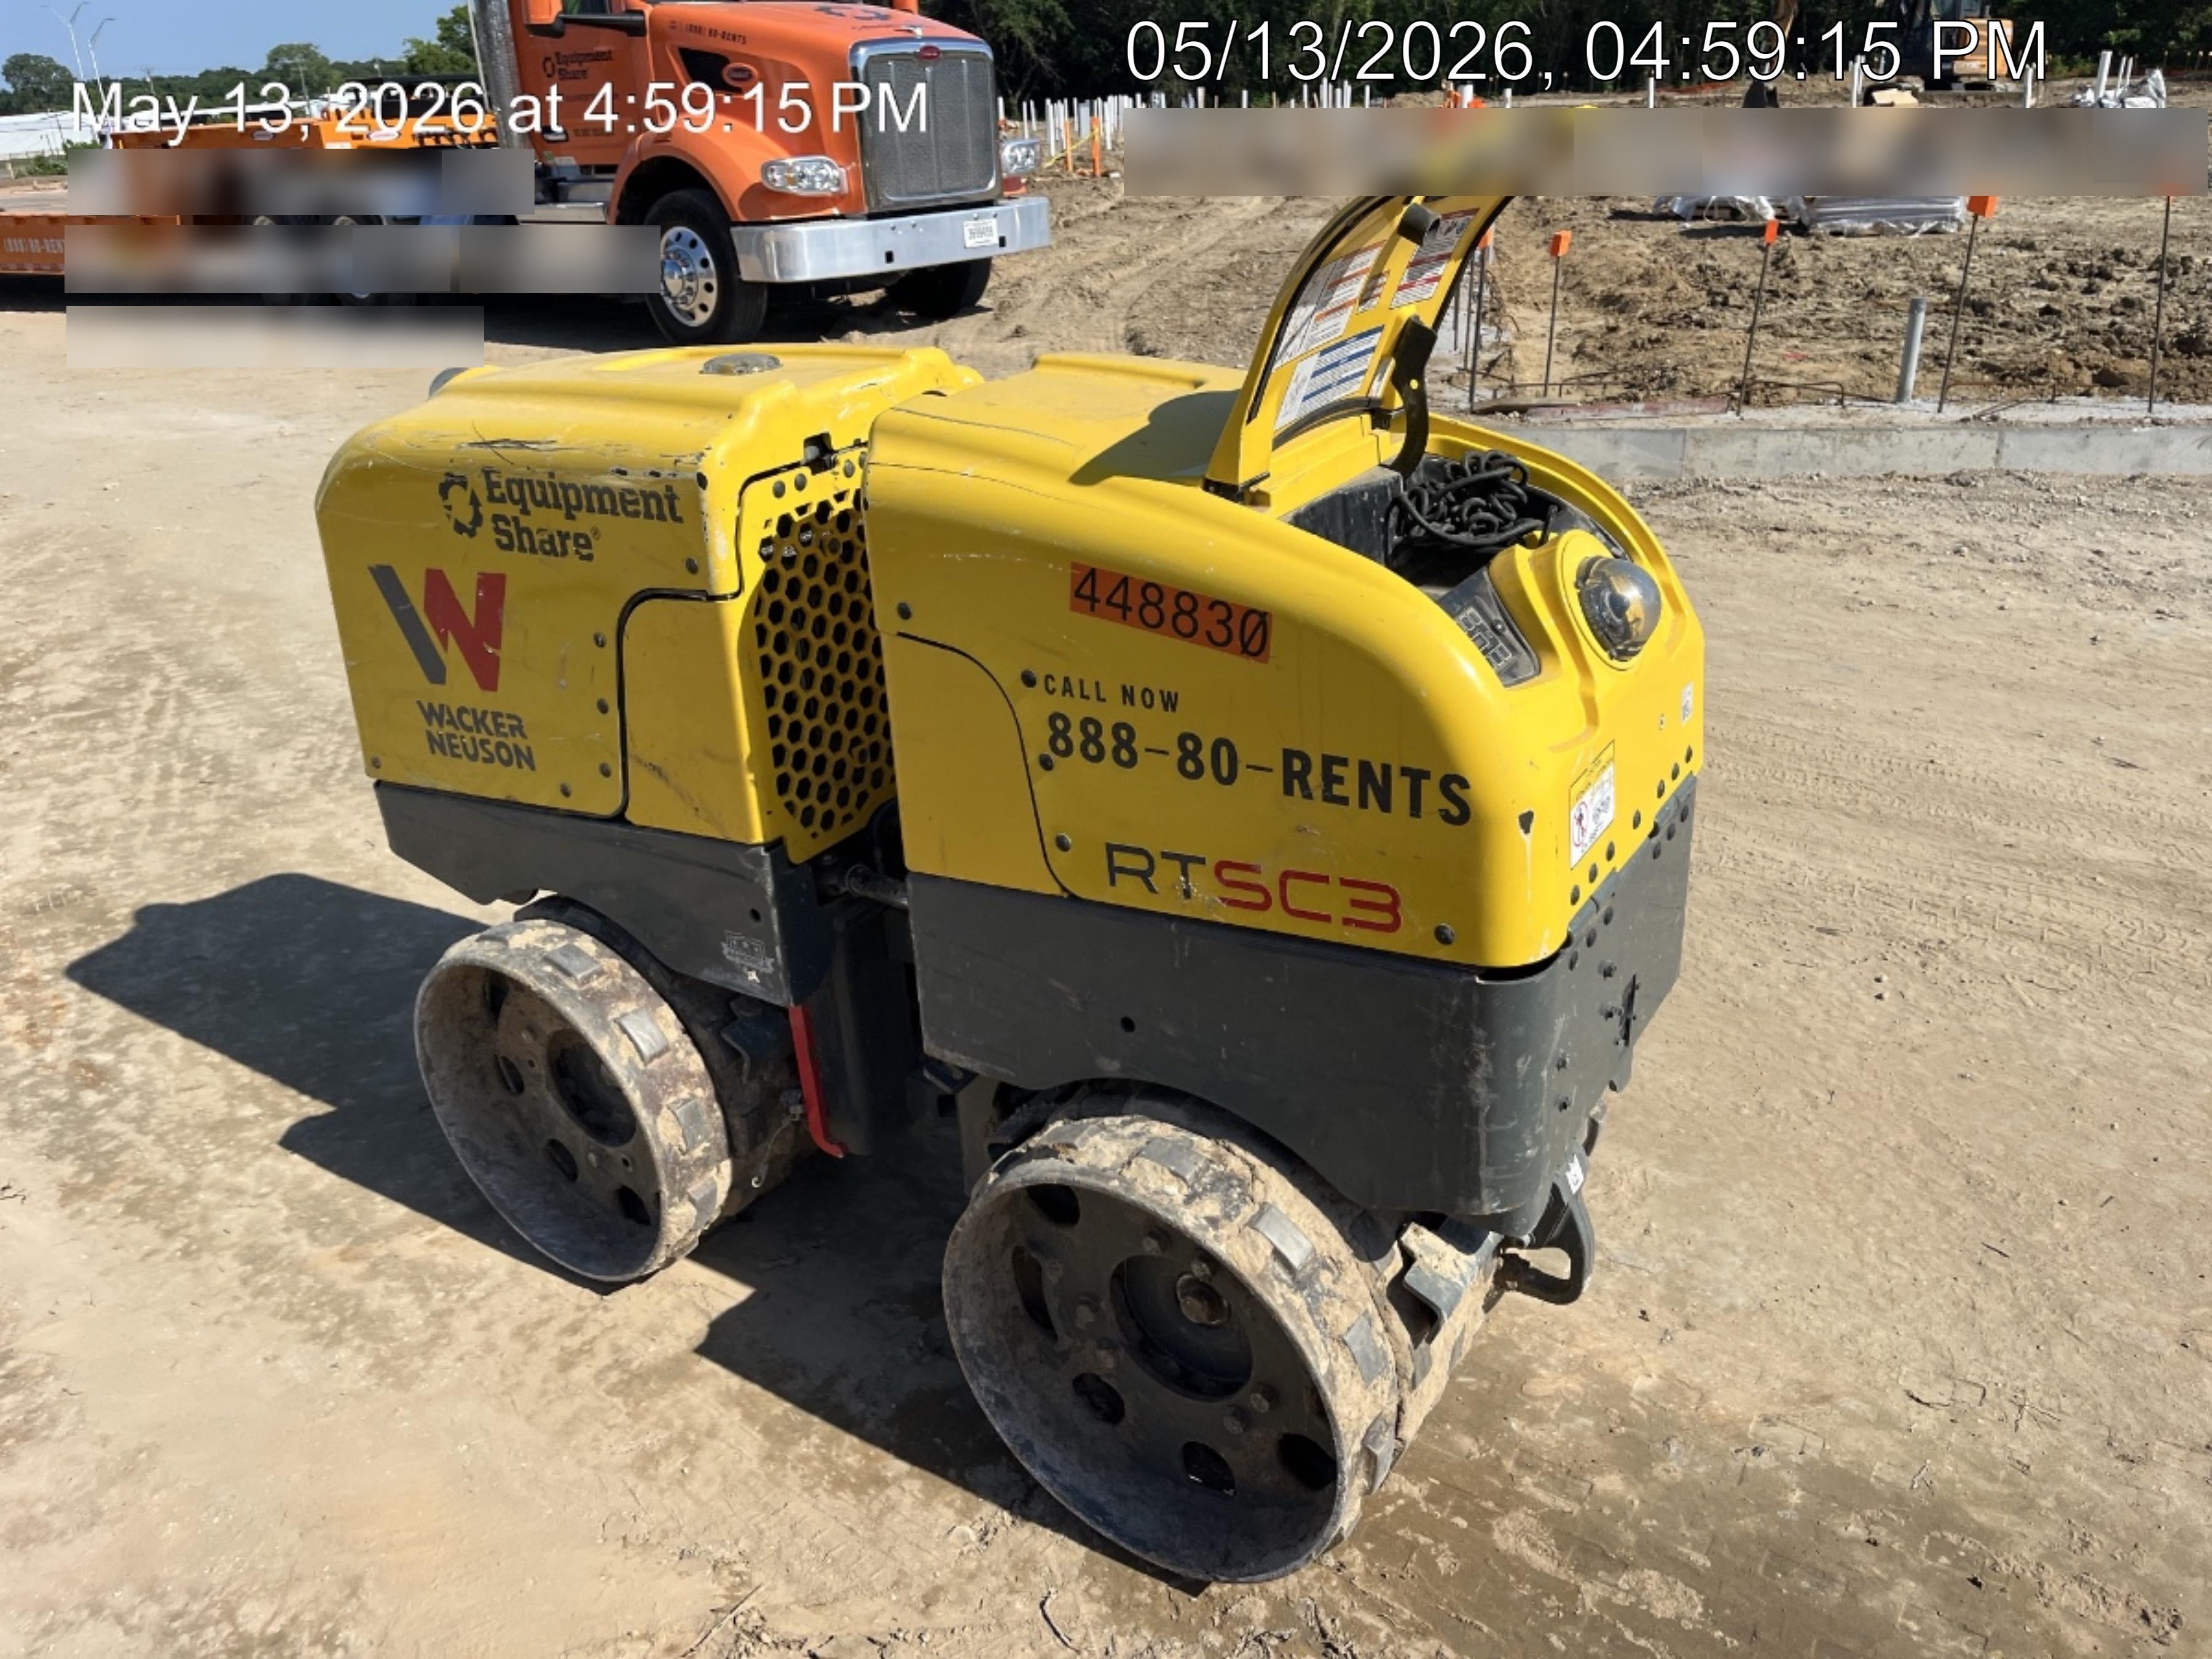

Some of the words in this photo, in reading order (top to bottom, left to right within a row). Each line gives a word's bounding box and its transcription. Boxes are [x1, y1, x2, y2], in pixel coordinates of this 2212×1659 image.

[480, 466, 684, 524] Equipment
[1073, 567, 1270, 659] 448830
[1043, 674, 1107, 703] CALL
[1121, 684, 1179, 713] NOW
[416, 699, 528, 740] WACKER
[425, 729, 536, 772] NEUSON
[1048, 712, 1472, 827] 888-80-RENTS
